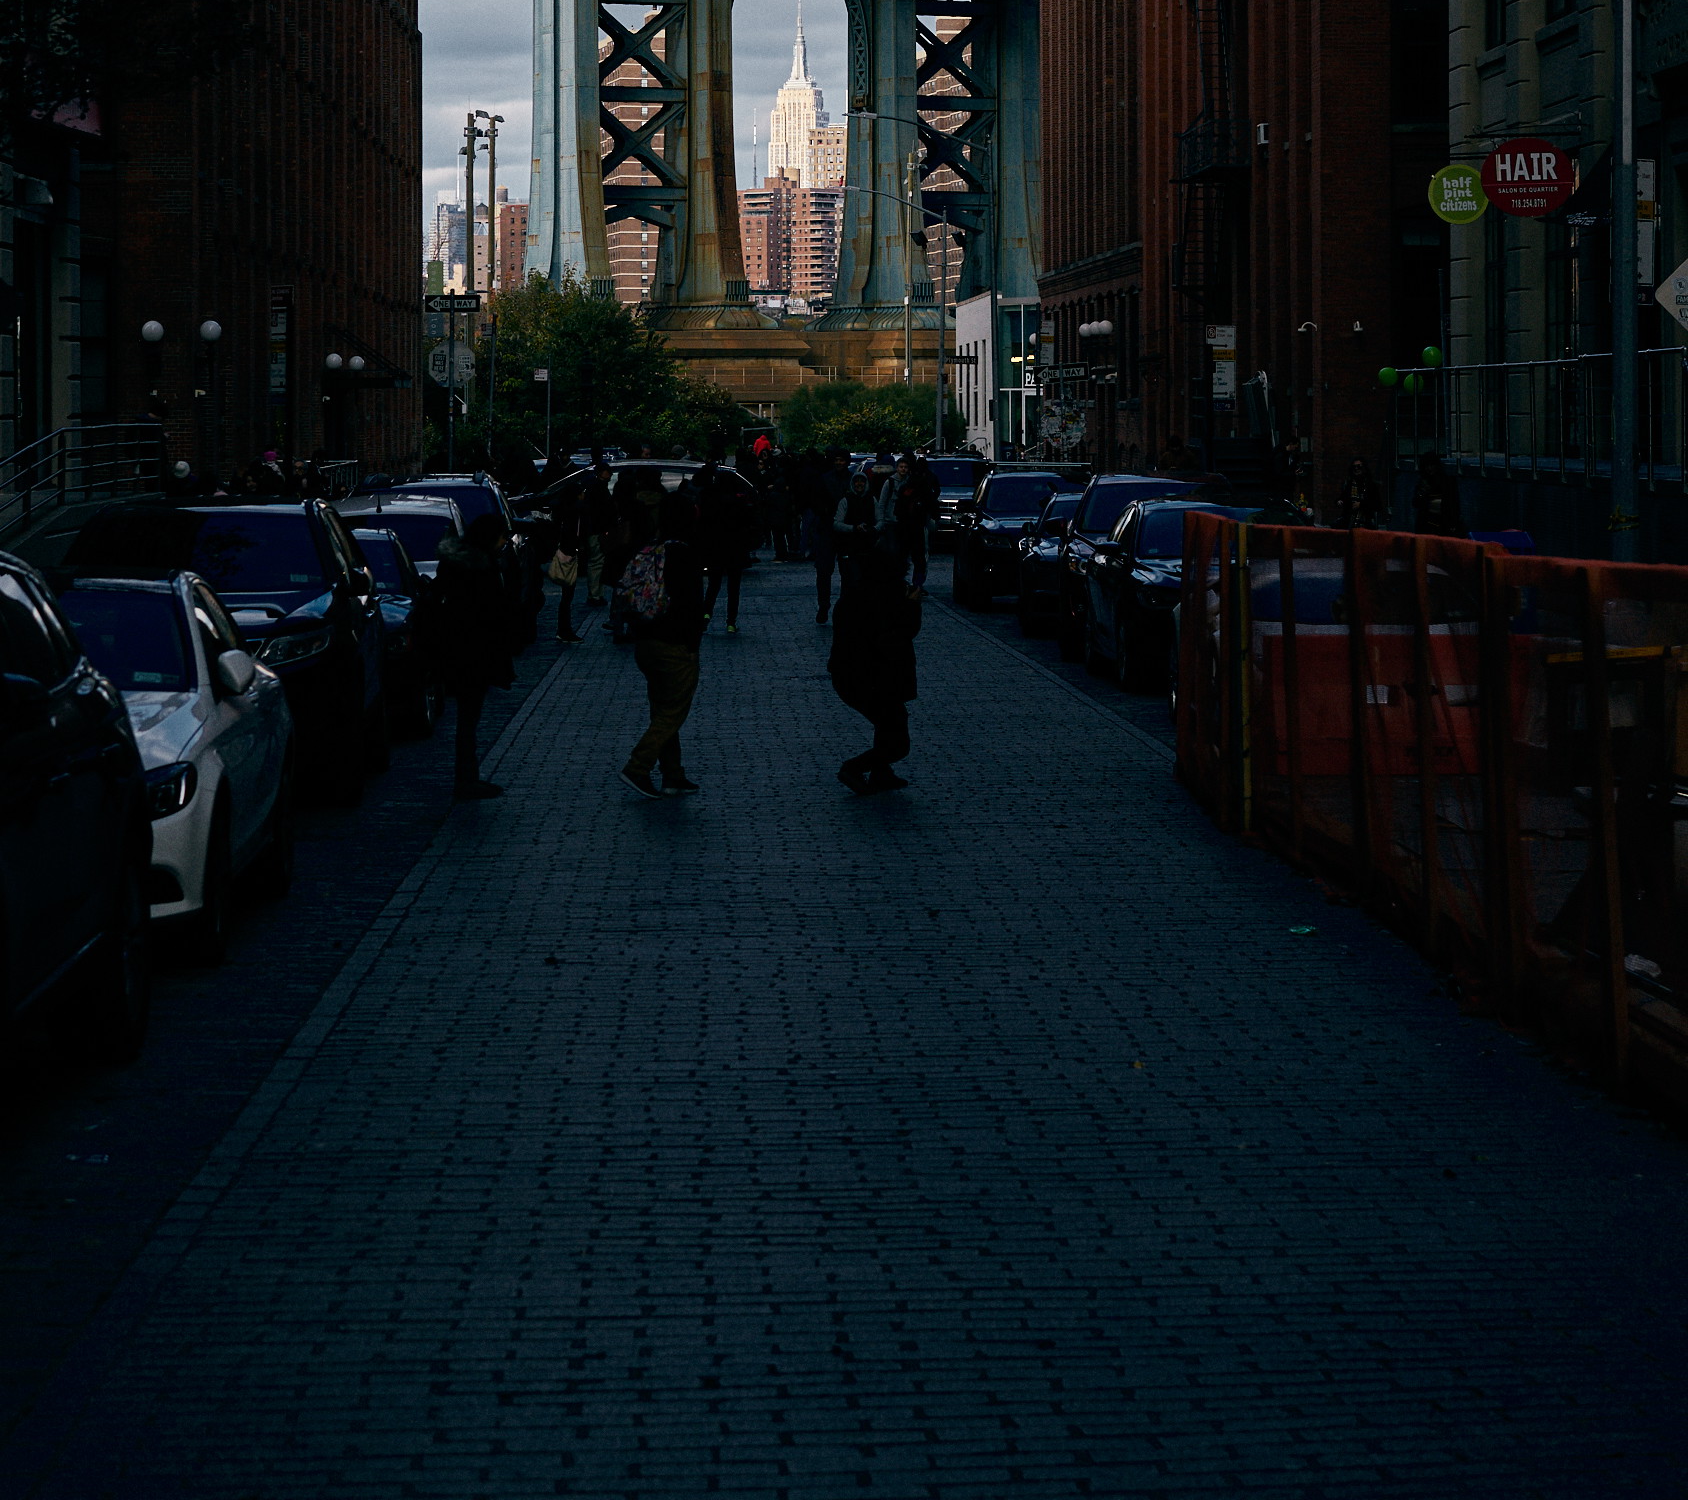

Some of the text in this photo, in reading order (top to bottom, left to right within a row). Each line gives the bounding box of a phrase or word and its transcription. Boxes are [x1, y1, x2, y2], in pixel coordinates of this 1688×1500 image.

[1495, 152, 1558, 182] HAIR
[1442, 176, 1473, 189] half
[1443, 188, 1473, 200] pint
[1440, 198, 1478, 212] citizens
[433, 300, 473, 308] ONE WAY
[1042, 368, 1081, 378] ONE WAY
